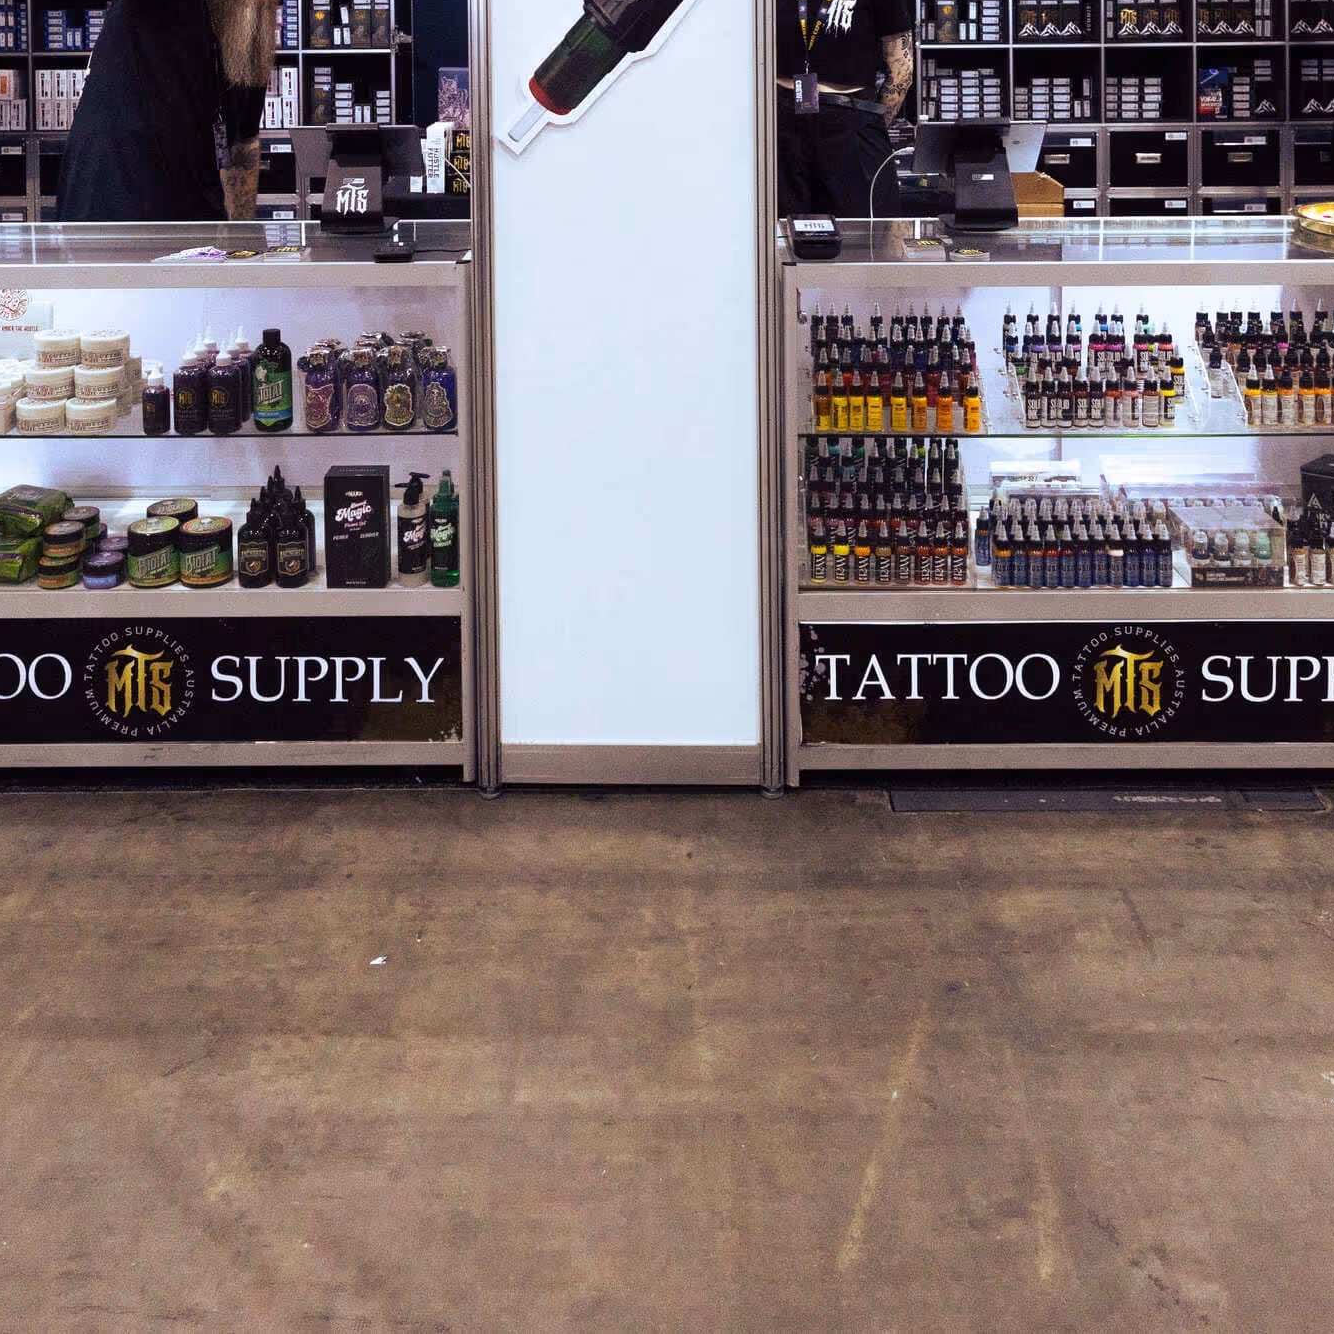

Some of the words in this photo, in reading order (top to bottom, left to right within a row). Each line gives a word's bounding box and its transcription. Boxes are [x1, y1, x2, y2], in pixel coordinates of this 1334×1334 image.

[335, 183, 369, 215] MTS
[335, 504, 372, 522] Magic
[84, 633, 118, 681] TATTOO
[125, 626, 189, 662] SUPPLIES
[816, 654, 1060, 699] TATTOO
[1072, 633, 1107, 682] TATTOO
[1114, 626, 1180, 662] SUPPLIES
[105, 644, 174, 718] MTS
[212, 656, 443, 702] SUPPLY
[1093, 644, 1164, 718] MTS
